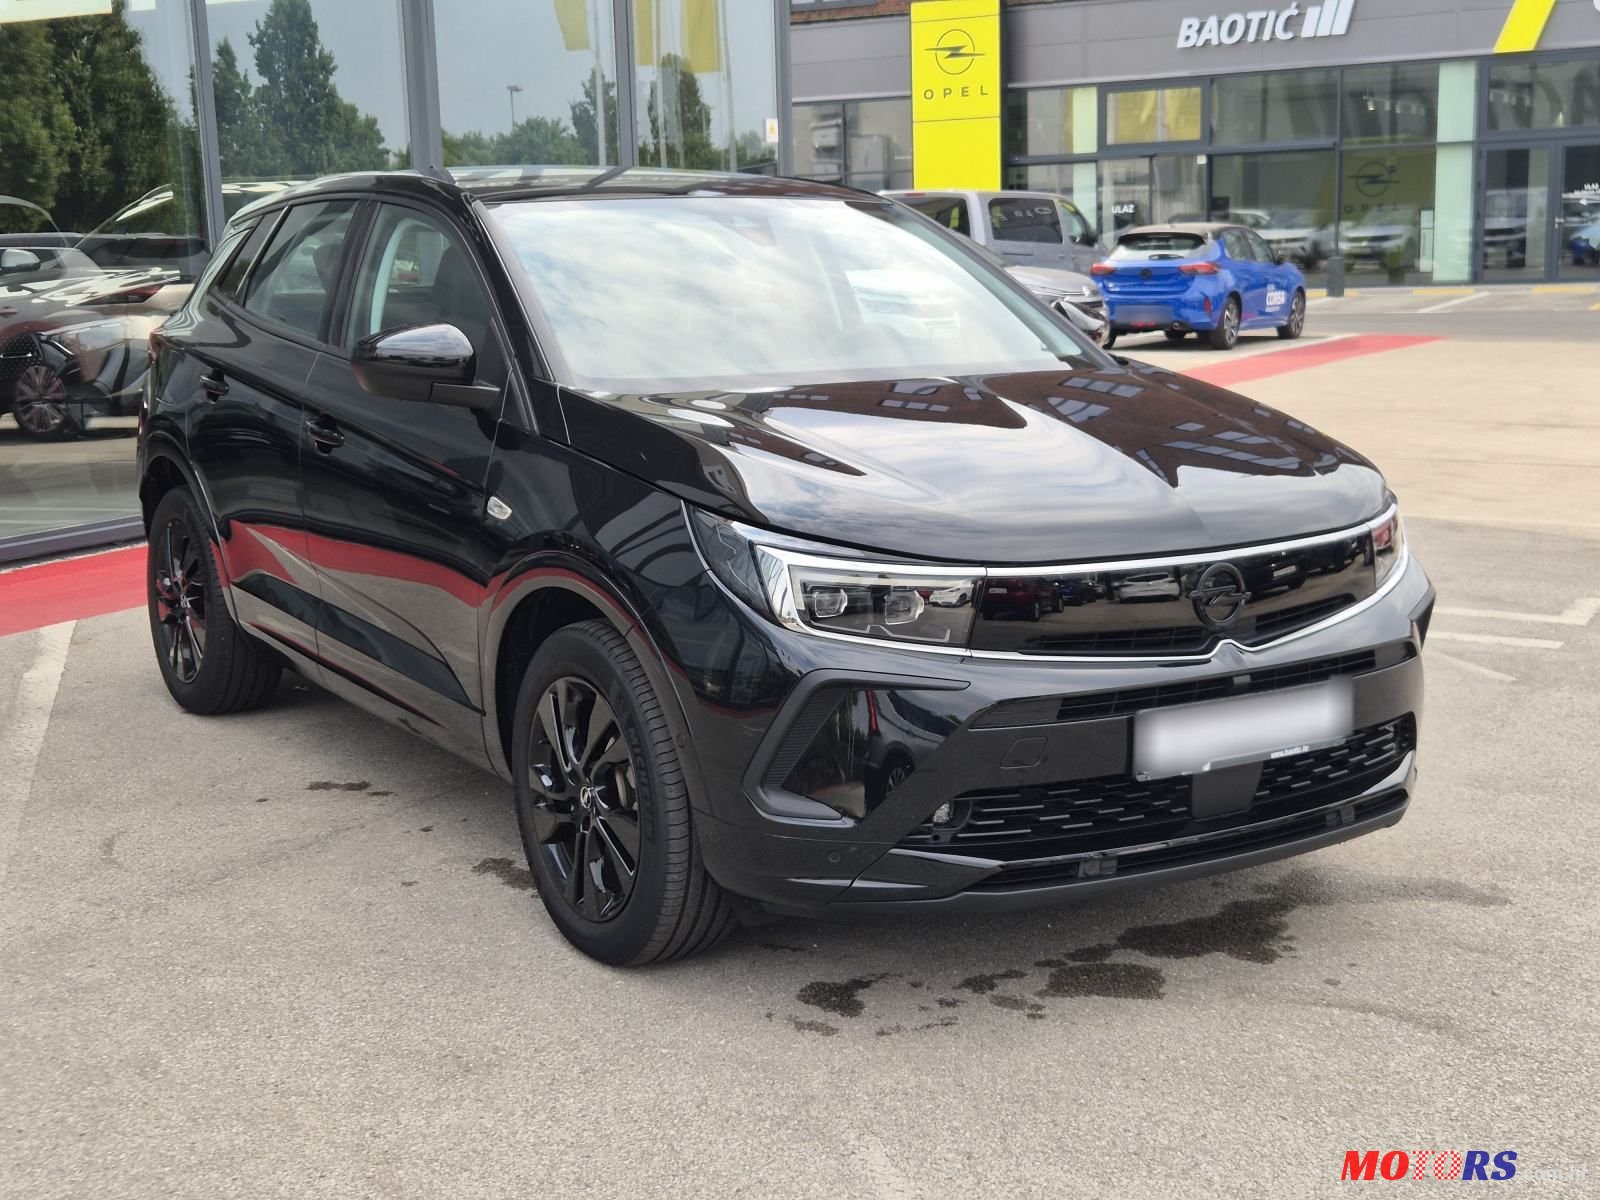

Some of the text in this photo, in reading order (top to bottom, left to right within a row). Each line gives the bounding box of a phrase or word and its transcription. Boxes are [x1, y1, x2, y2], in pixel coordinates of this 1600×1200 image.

[1177, 2, 1299, 48] BAOTIĆ
[923, 85, 988, 100] OPEL
[1111, 204, 1135, 214] ULAZ
[1343, 202, 1401, 214] OPEL
